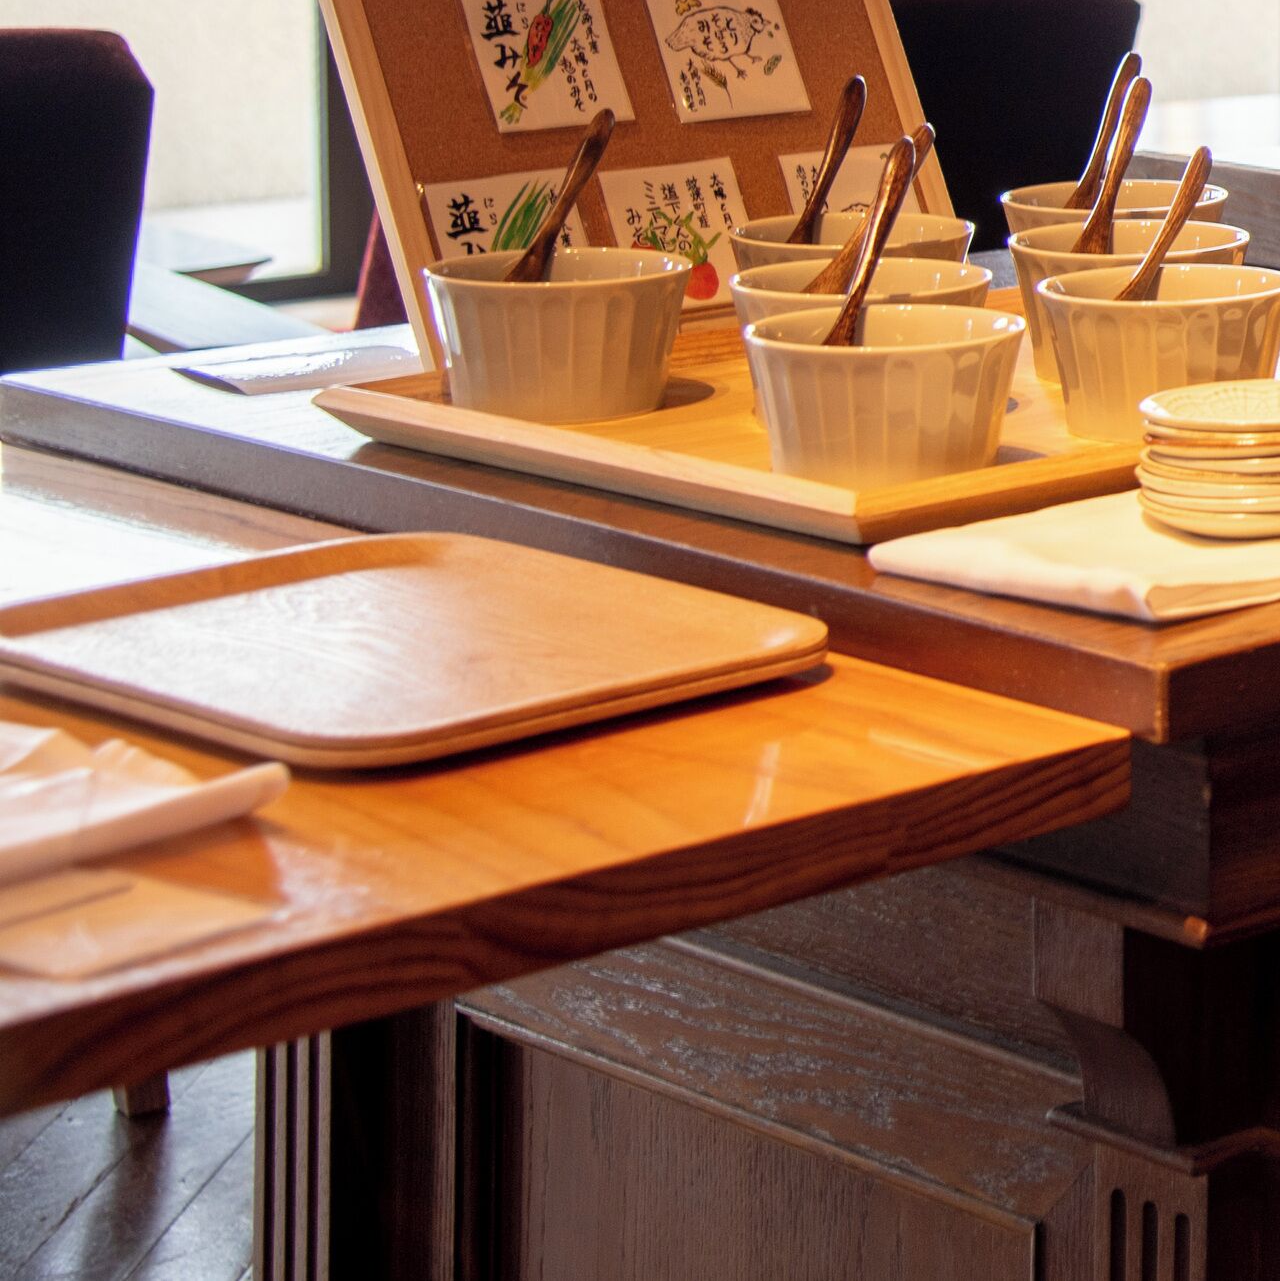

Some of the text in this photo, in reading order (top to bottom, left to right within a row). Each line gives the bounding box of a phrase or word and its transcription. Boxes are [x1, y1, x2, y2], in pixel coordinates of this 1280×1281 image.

[516, 1, 529, 30] にら
[725, 17, 738, 47] とり
[697, 19, 714, 52] みそ
[710, 12, 729, 54] そぼろ
[570, 37, 598, 103] 太陽と月の
[483, 197, 498, 226] にら
[625, 206, 648, 248] みそ
